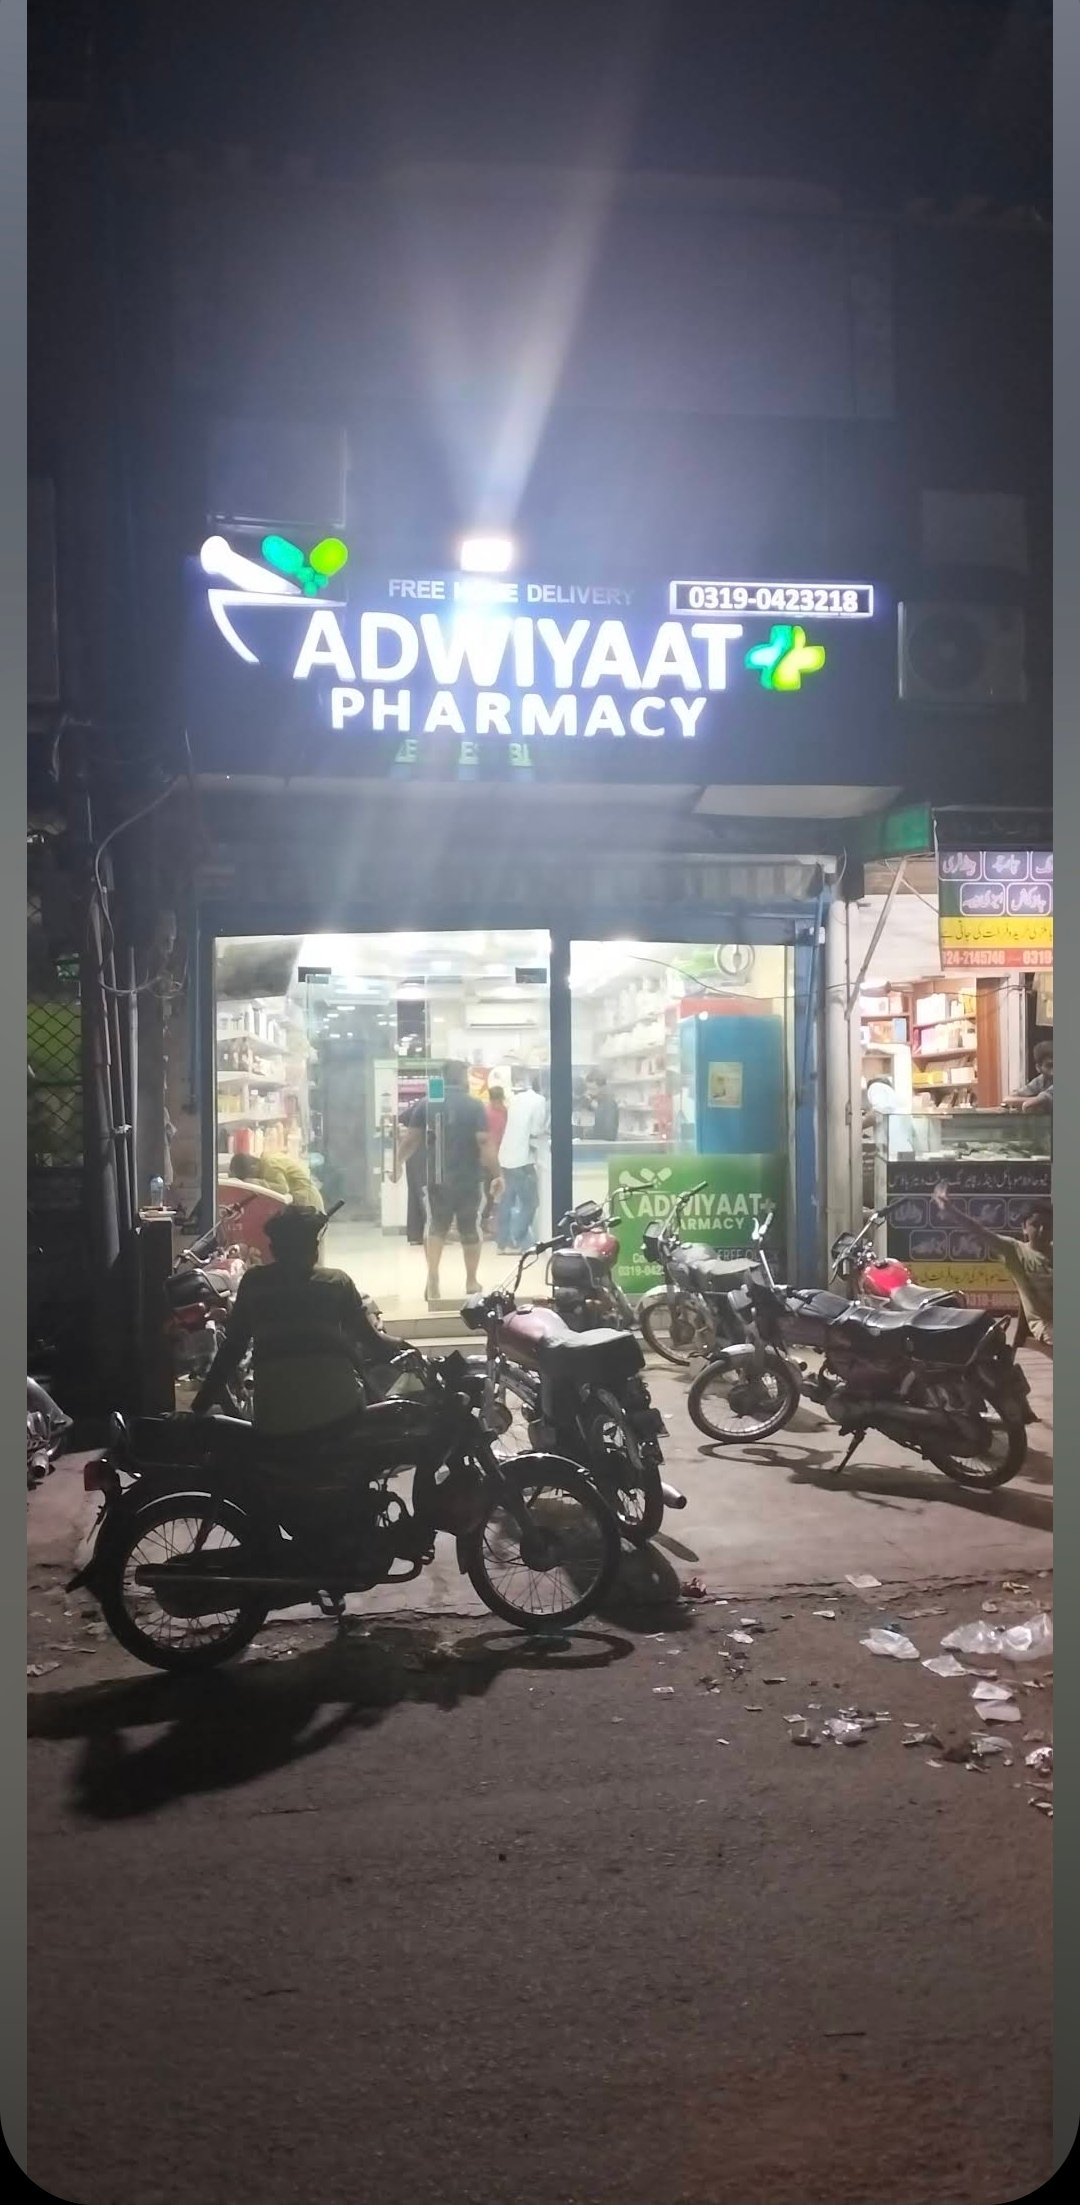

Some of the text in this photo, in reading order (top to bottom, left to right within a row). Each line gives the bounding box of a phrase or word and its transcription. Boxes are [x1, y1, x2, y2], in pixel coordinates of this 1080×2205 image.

[388, 579, 633, 605] FREE HE DELIVERY
[689, 586, 859, 612] 0319-0423218
[292, 610, 743, 691] ADWIYAAT
[330, 687, 708, 738] PHARMACY
[654, 1217, 744, 1230] ARMACY
